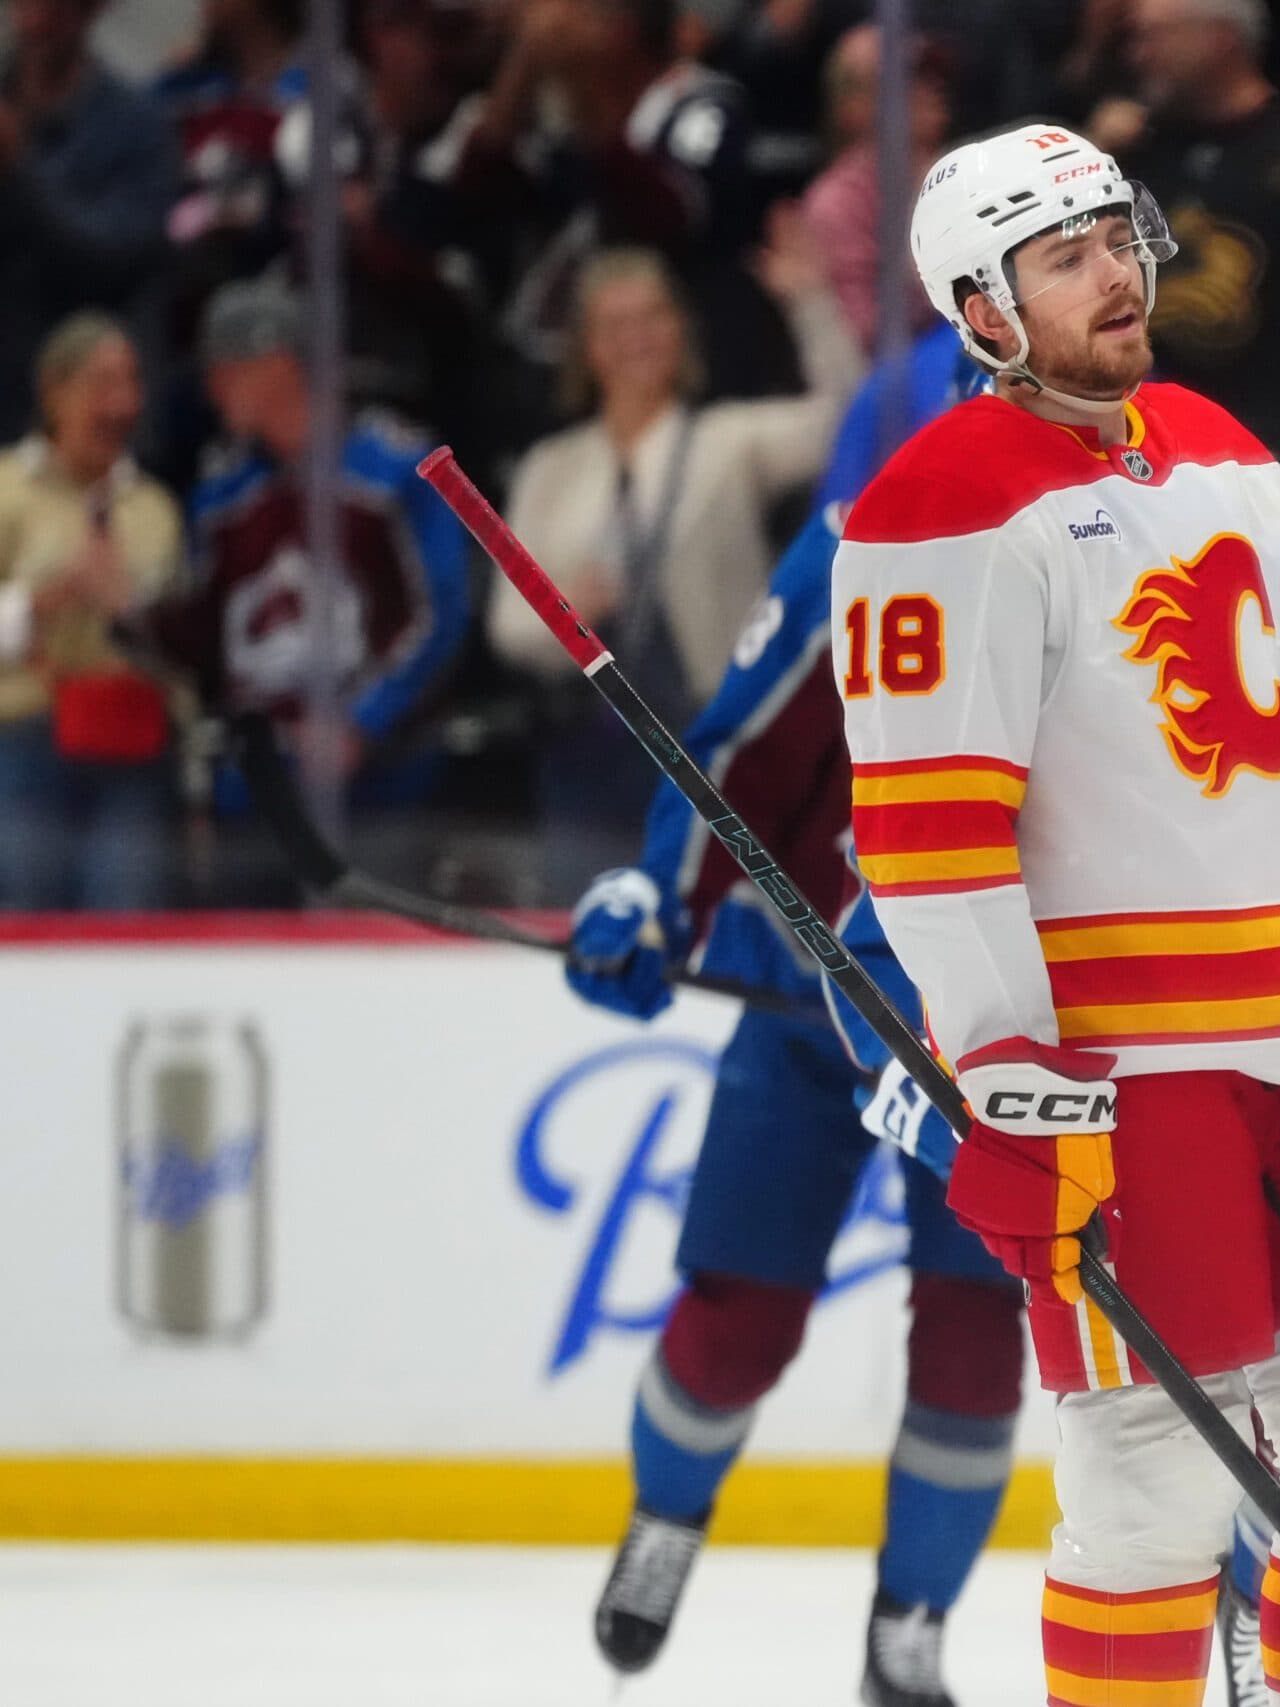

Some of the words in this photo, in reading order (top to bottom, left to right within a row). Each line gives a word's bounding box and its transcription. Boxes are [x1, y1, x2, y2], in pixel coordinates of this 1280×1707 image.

[1054, 162, 1101, 184] CCM
[1068, 522, 1117, 540] SUNCOR
[844, 592, 946, 701] 18
[708, 814, 850, 973] CCM
[985, 1091, 1118, 1123] CCM
